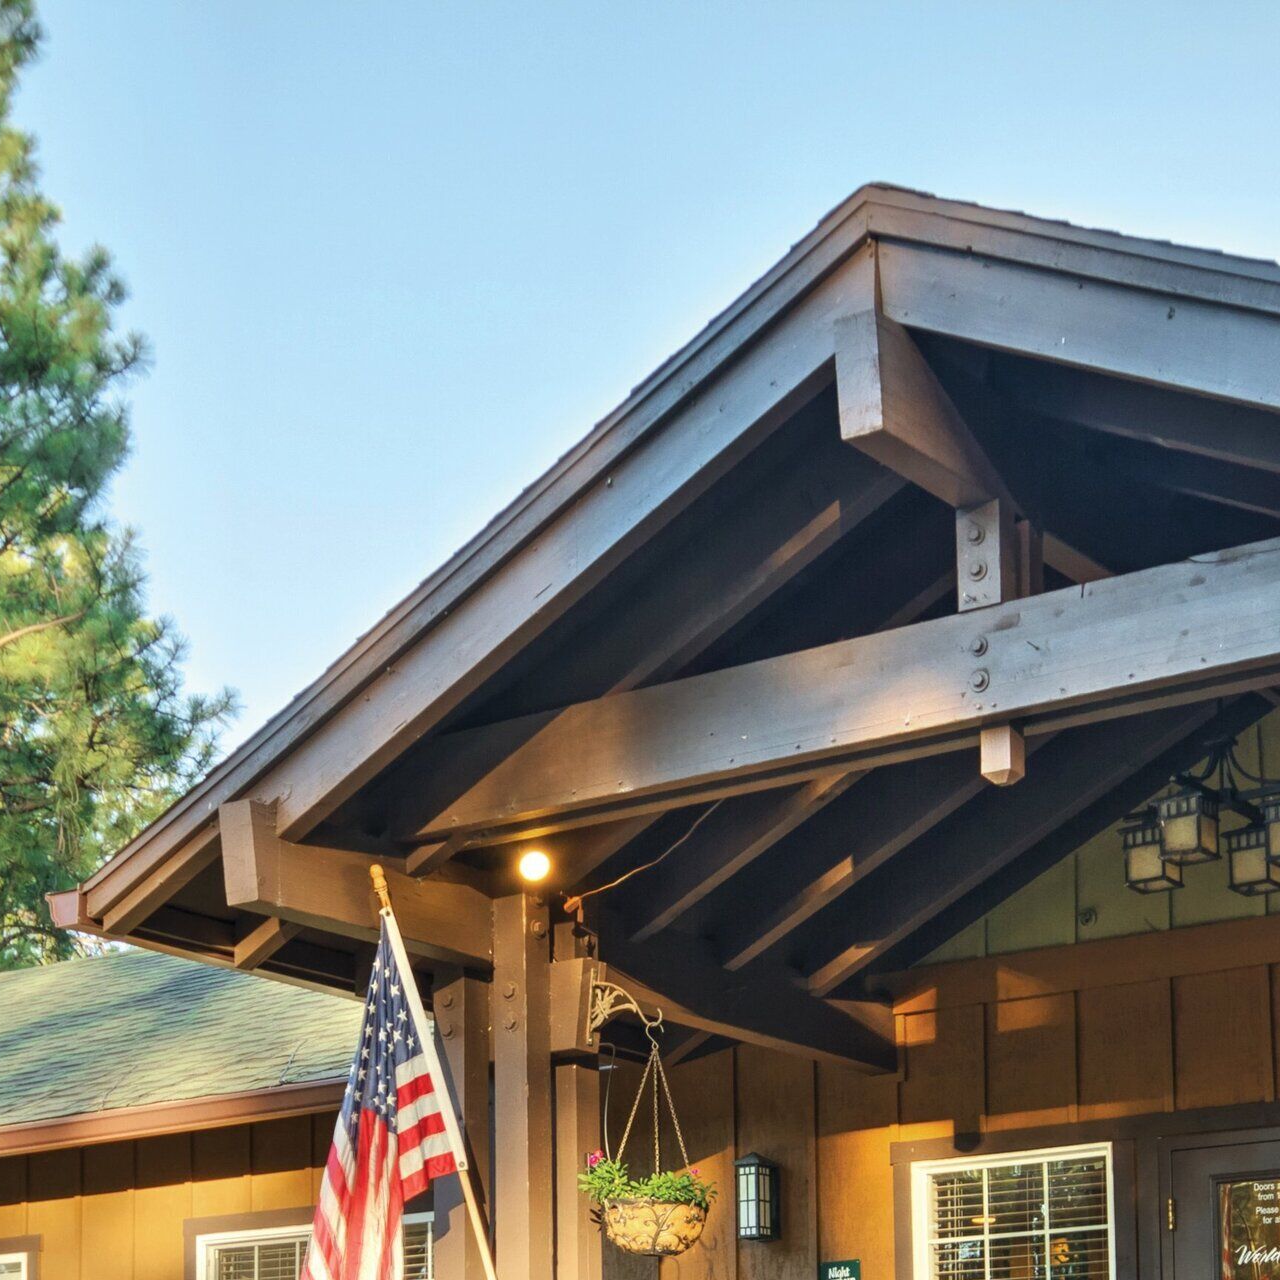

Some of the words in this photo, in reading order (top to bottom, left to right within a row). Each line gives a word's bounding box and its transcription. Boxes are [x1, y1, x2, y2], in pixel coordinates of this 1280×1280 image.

[1253, 1183, 1275, 1191] Doors
[1258, 1193, 1274, 1201] from
[1255, 1206, 1279, 1215] Please
[1262, 1216, 1273, 1224] for
[828, 1266, 850, 1280] Night
